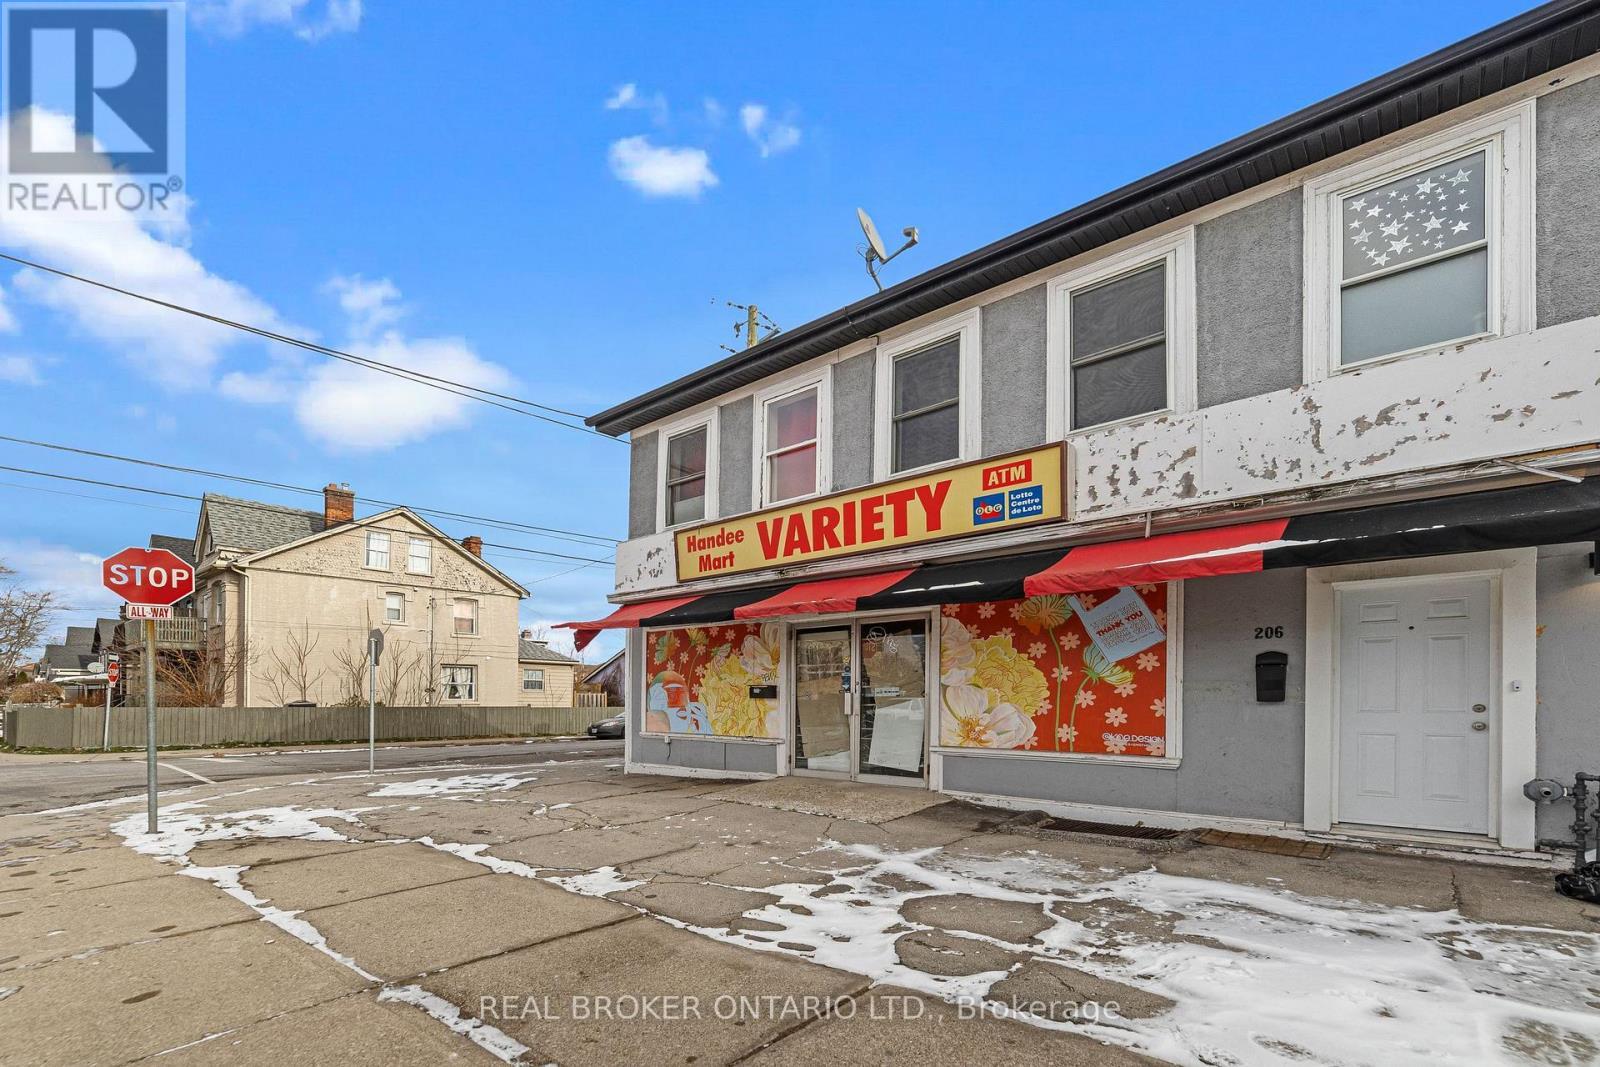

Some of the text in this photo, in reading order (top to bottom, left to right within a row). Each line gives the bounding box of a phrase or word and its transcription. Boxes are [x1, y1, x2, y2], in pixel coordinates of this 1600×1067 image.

[988, 464, 1026, 486] ATM
[1010, 491, 1033, 500] Lotto
[1011, 498, 1040, 507] Centre
[1022, 504, 1042, 513] Loto
[756, 479, 953, 561] VARIETY
[686, 527, 745, 553] Handee
[698, 550, 735, 573] Mart
[109, 563, 189, 588] STOP
[1096, 619, 1125, 637] THANK
[1125, 610, 1143, 622] YOU
[1254, 626, 1284, 639] 206
